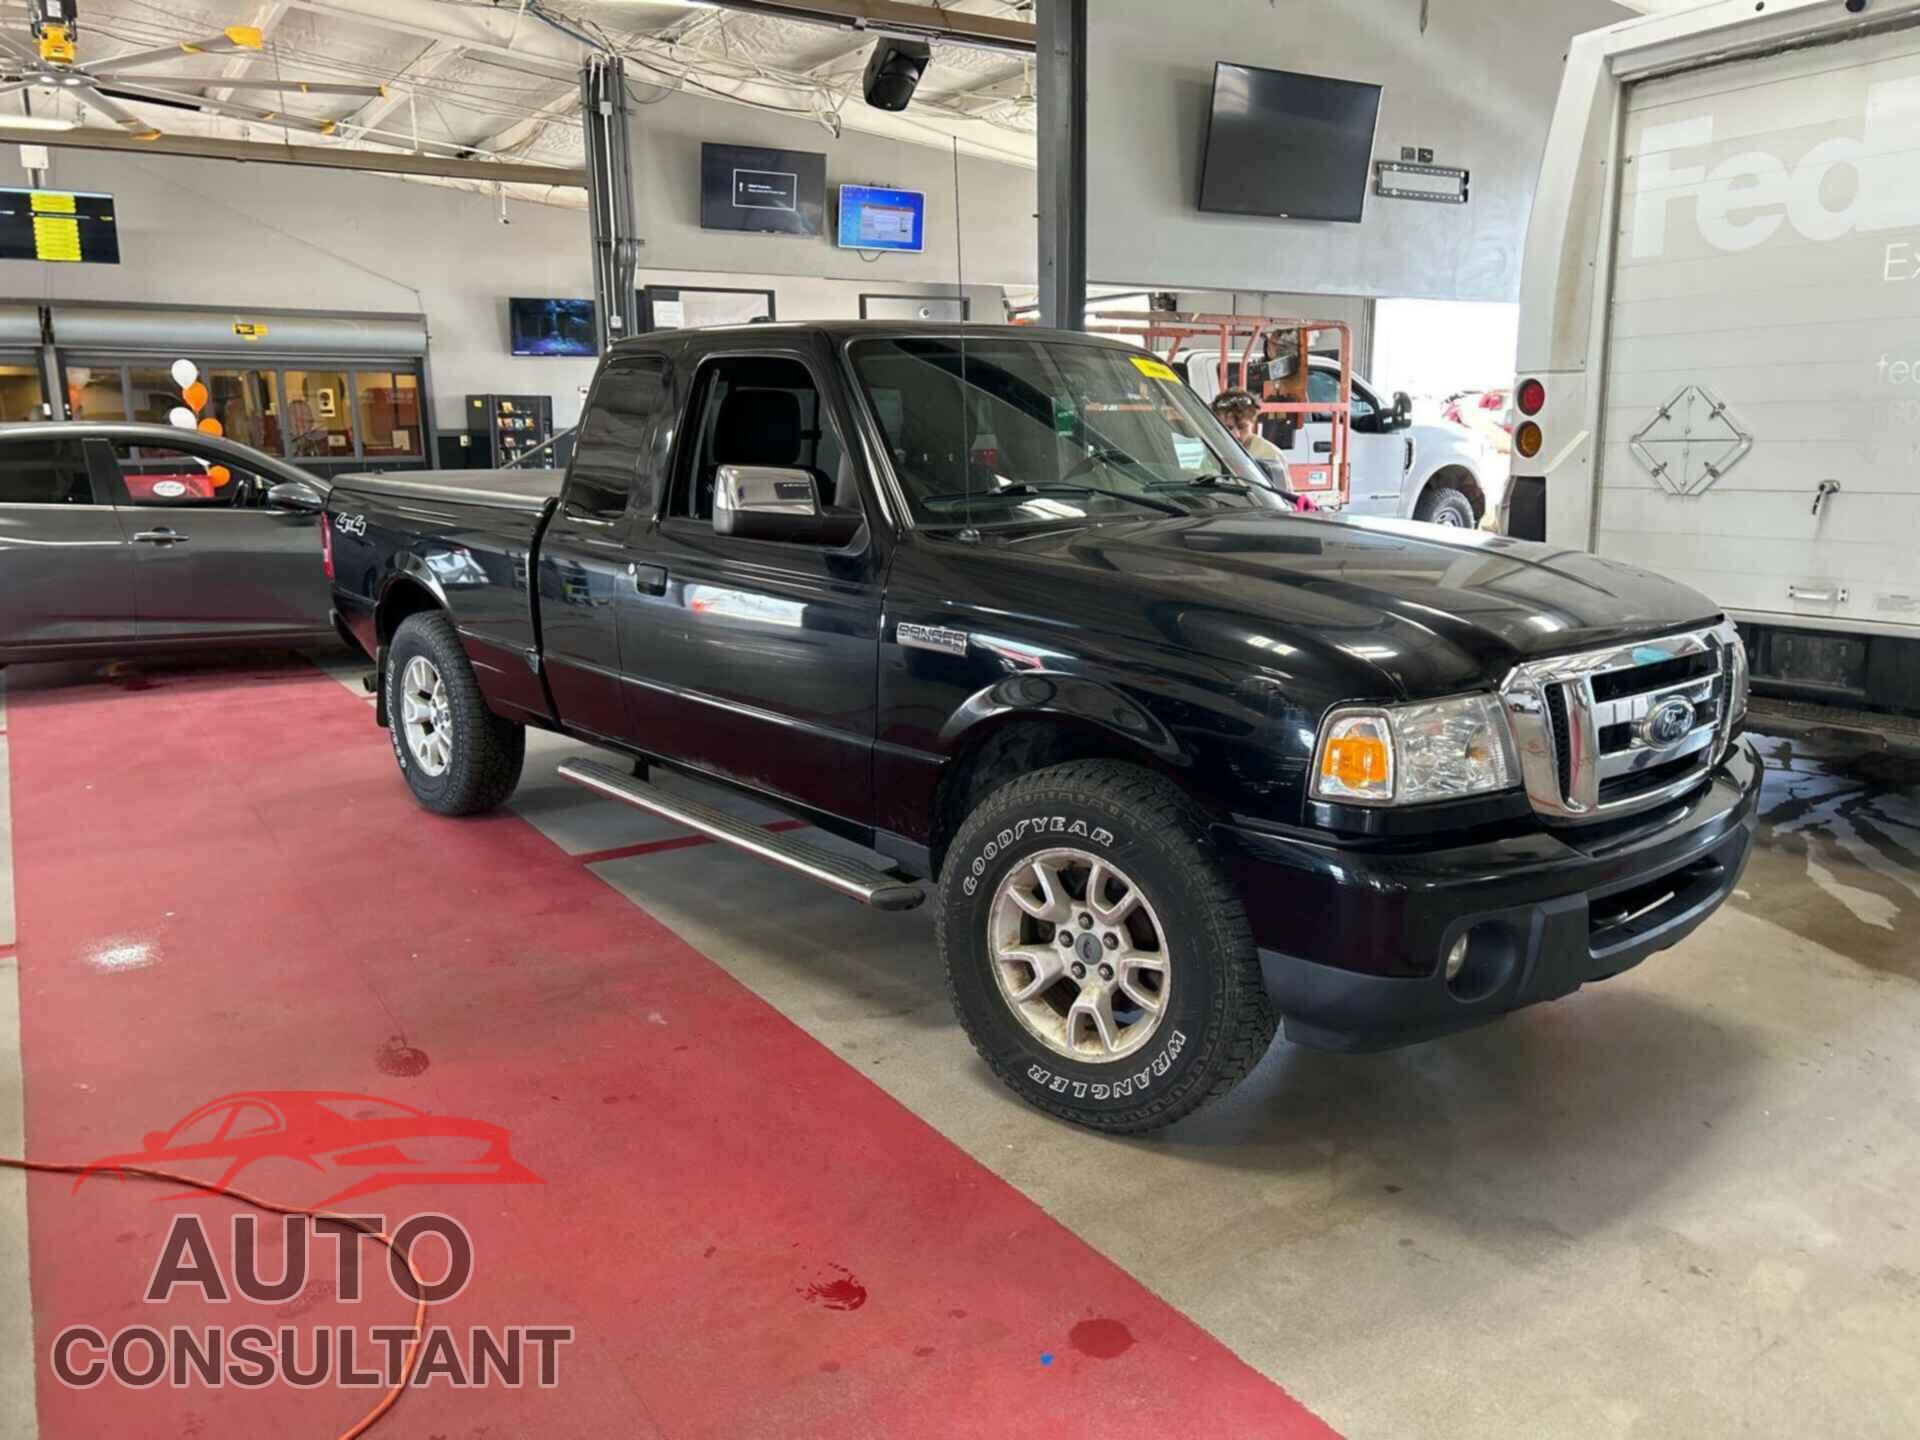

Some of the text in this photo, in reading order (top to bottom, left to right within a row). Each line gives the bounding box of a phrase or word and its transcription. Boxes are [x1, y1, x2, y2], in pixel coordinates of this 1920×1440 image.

[336, 511, 367, 536] 4x4
[963, 816, 1114, 896] GOODYEAR
[1027, 1029, 1187, 1100] WRANGLER
